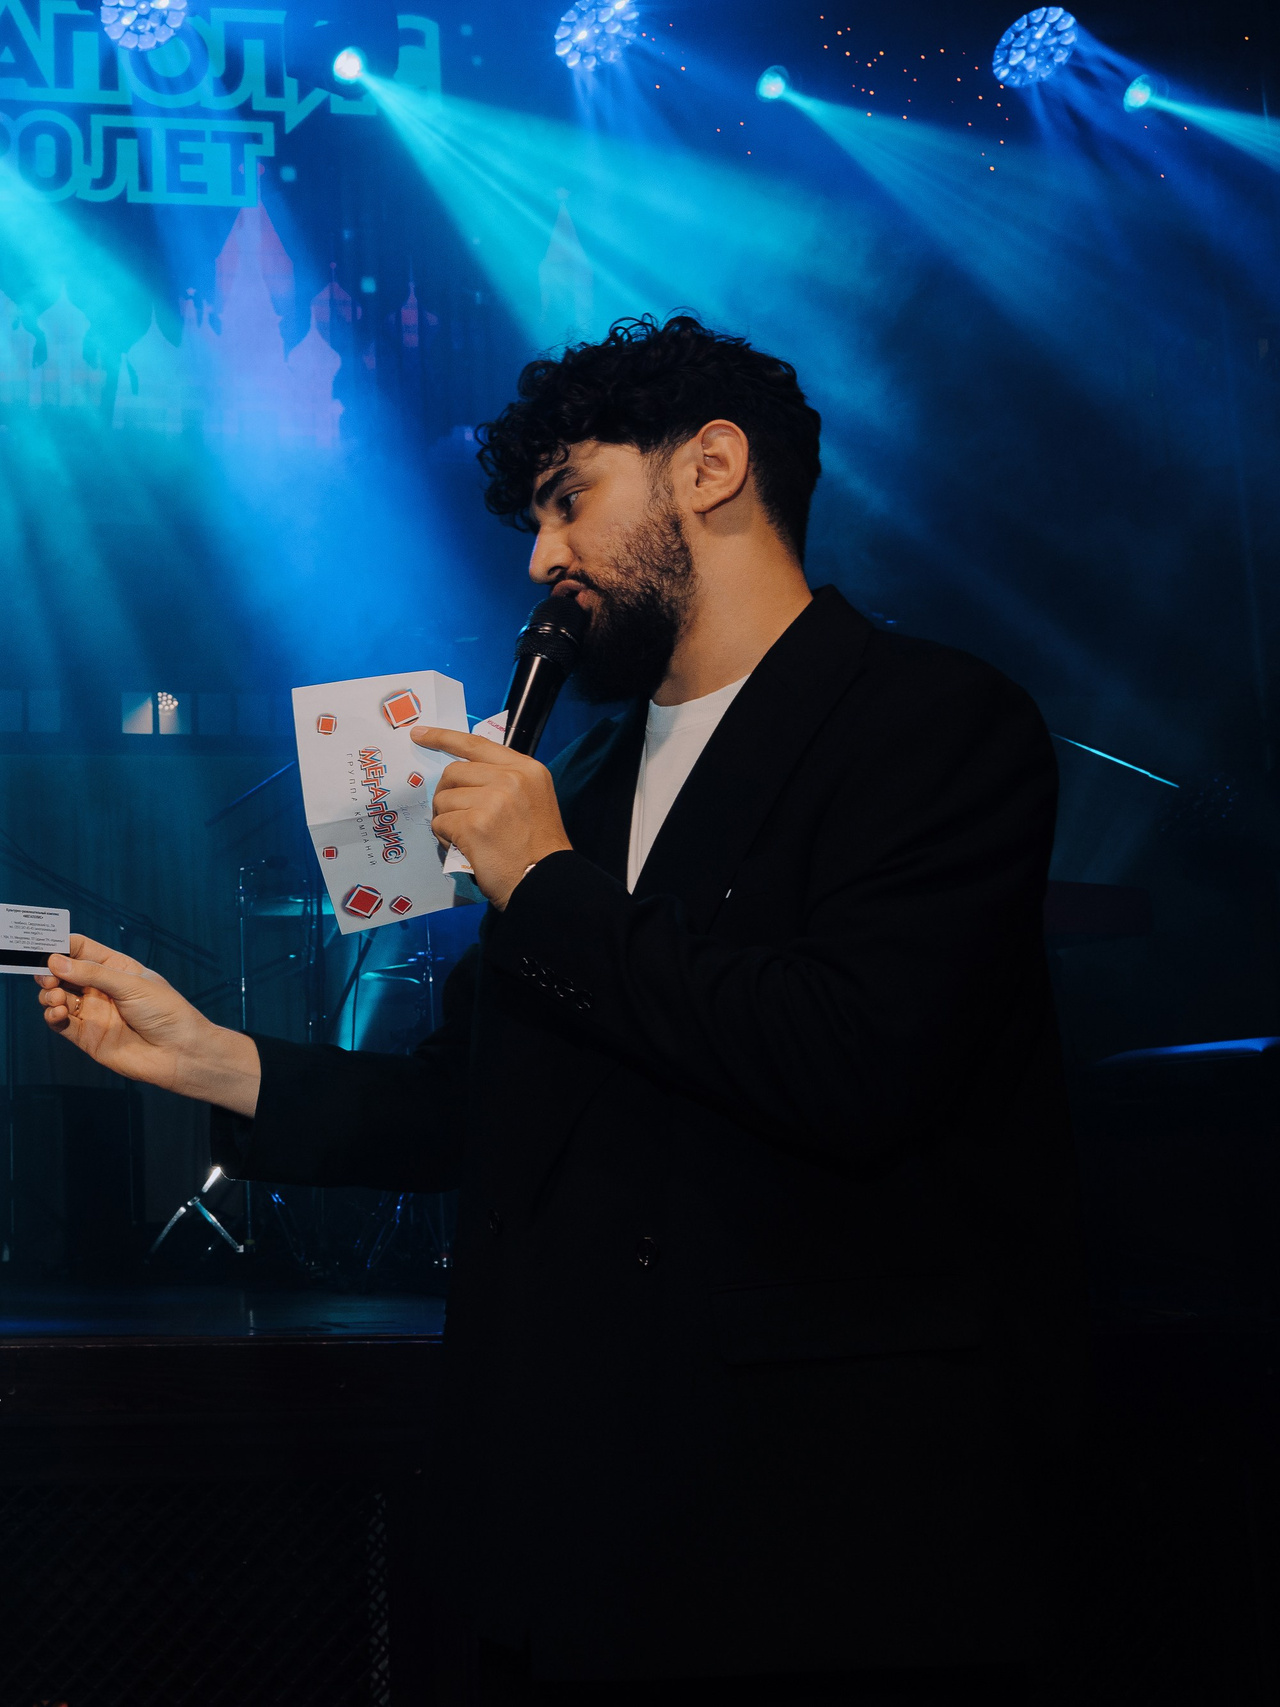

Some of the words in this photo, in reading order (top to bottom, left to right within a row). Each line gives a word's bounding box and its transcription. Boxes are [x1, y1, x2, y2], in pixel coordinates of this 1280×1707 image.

[346, 753, 358, 802] ГРУППА
[354, 811, 378, 866] КОМПАНИЙ
[358, 746, 406, 864] МЕГАПОЛИС
